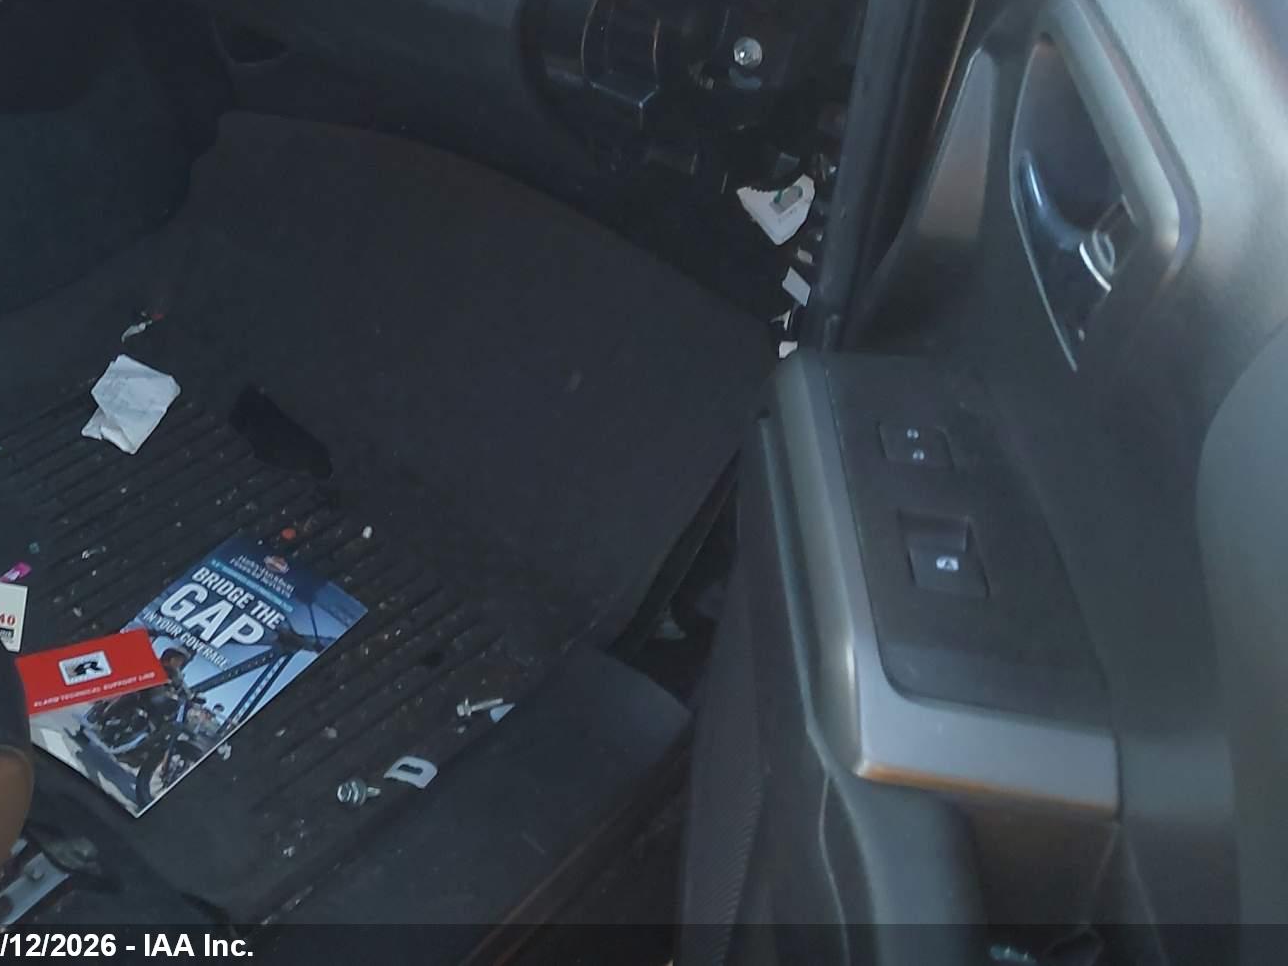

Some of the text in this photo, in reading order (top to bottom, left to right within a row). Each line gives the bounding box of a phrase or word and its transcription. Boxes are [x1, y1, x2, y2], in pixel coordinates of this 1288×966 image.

[143, 611, 158, 625] IN
[155, 617, 180, 639] YOUR
[161, 583, 265, 650] GAP
[192, 567, 255, 609] BRIDGE
[251, 599, 286, 630] THE
